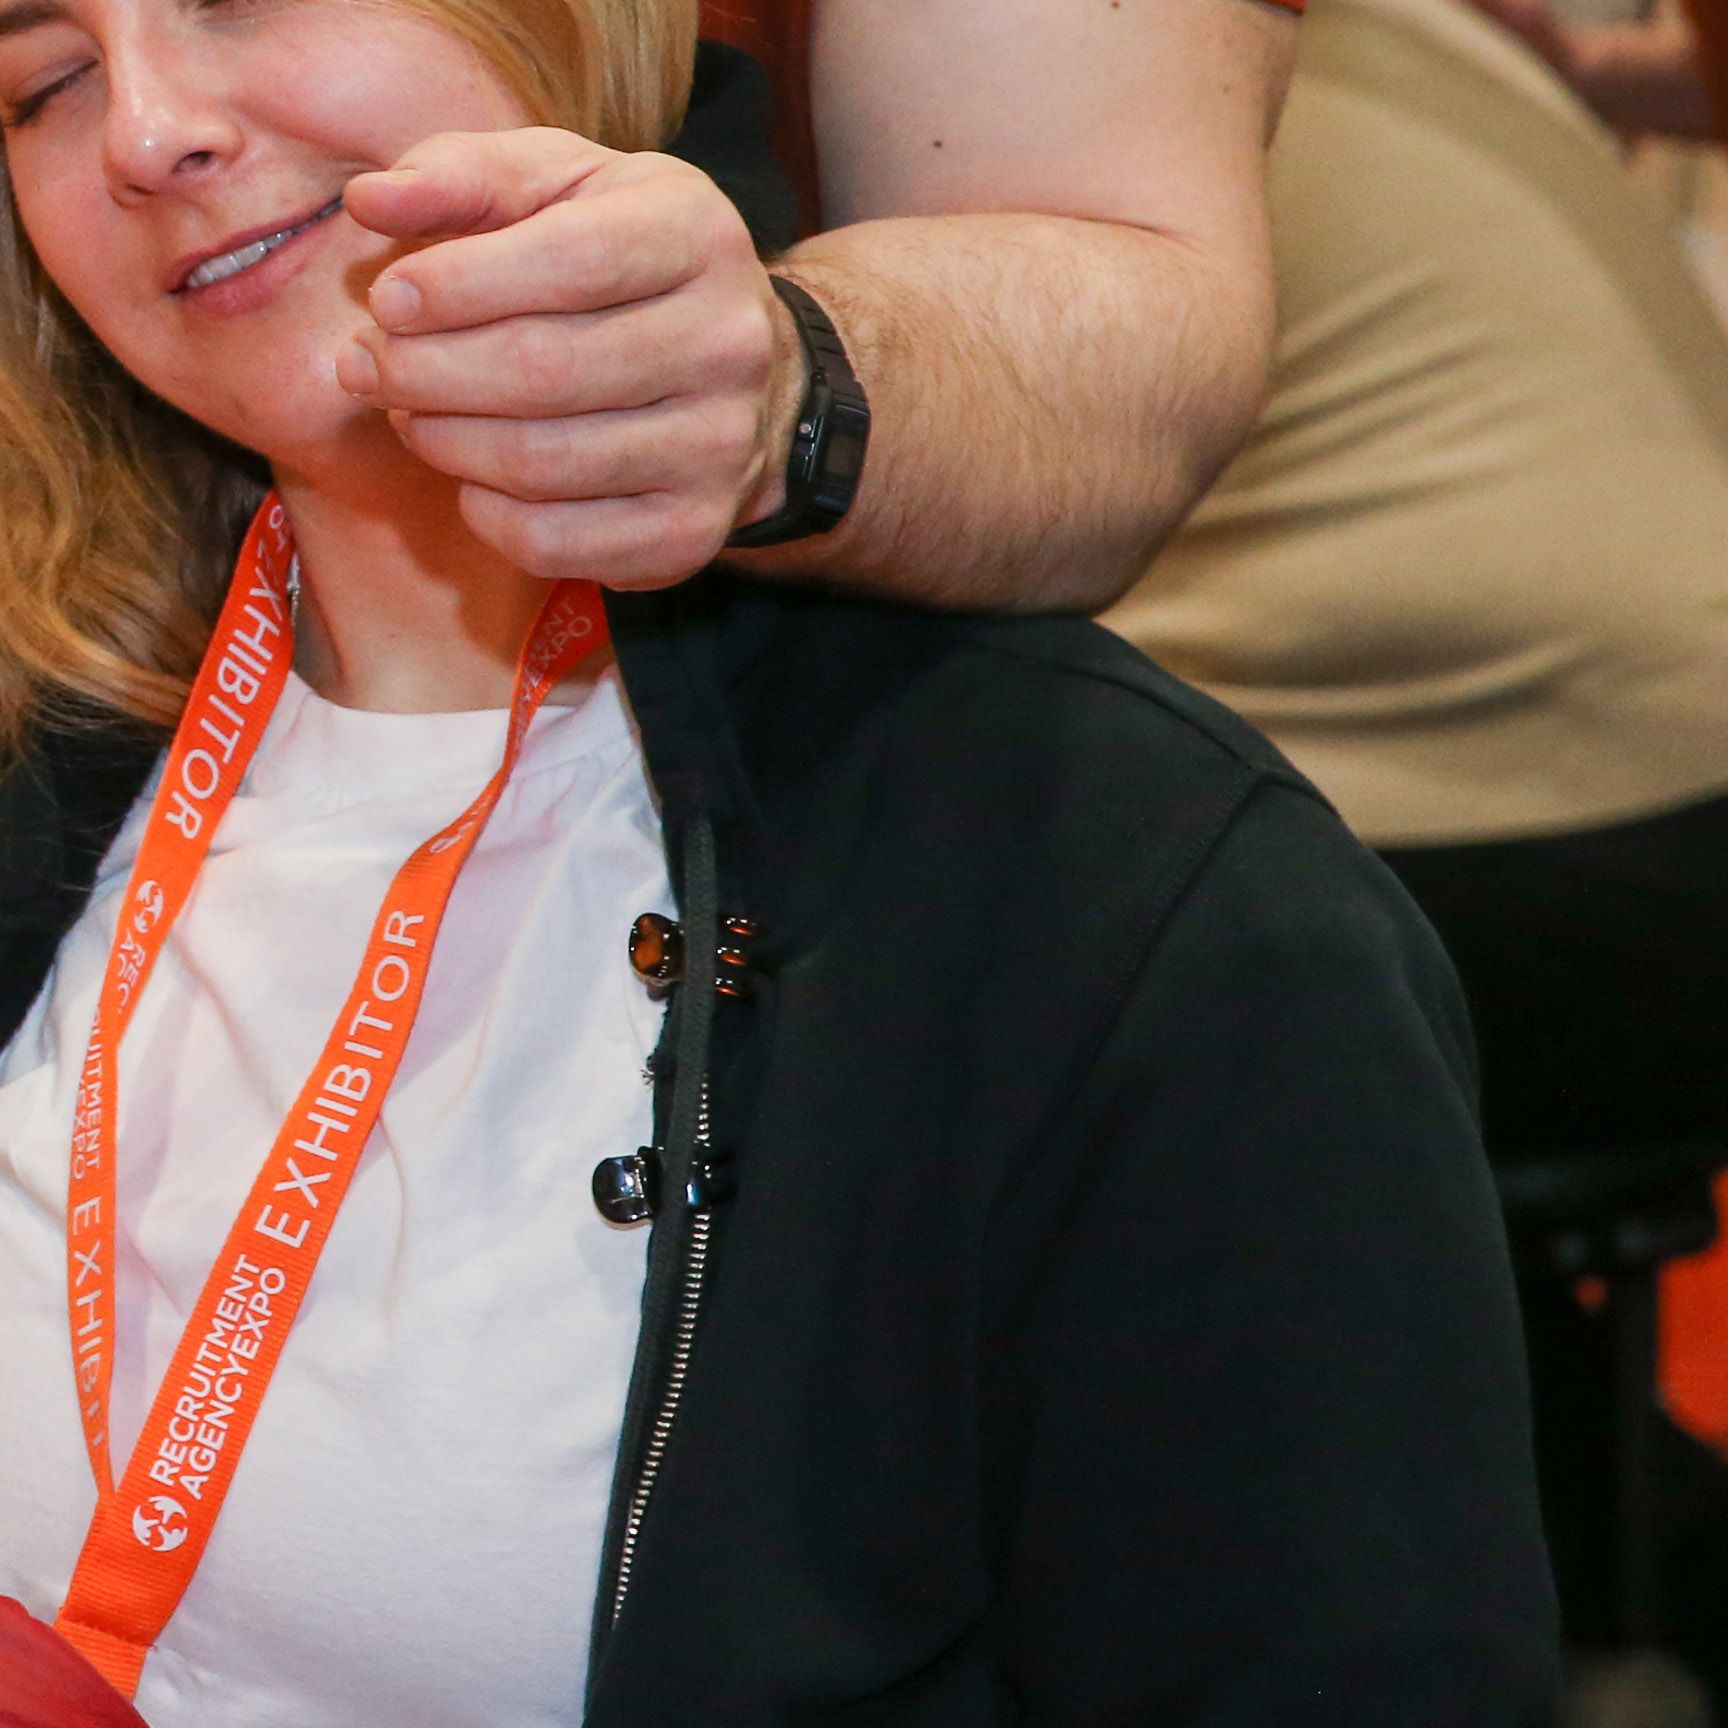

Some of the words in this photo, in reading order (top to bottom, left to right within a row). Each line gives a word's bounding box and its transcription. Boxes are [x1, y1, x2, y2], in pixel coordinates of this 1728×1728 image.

[164, 538, 282, 839] XHIBITOR
[255, 910, 425, 1249] EXHIBITOR
[149, 1253, 261, 1486] RECRUITMENT
[179, 1267, 286, 1500] AGENCYEXPO
